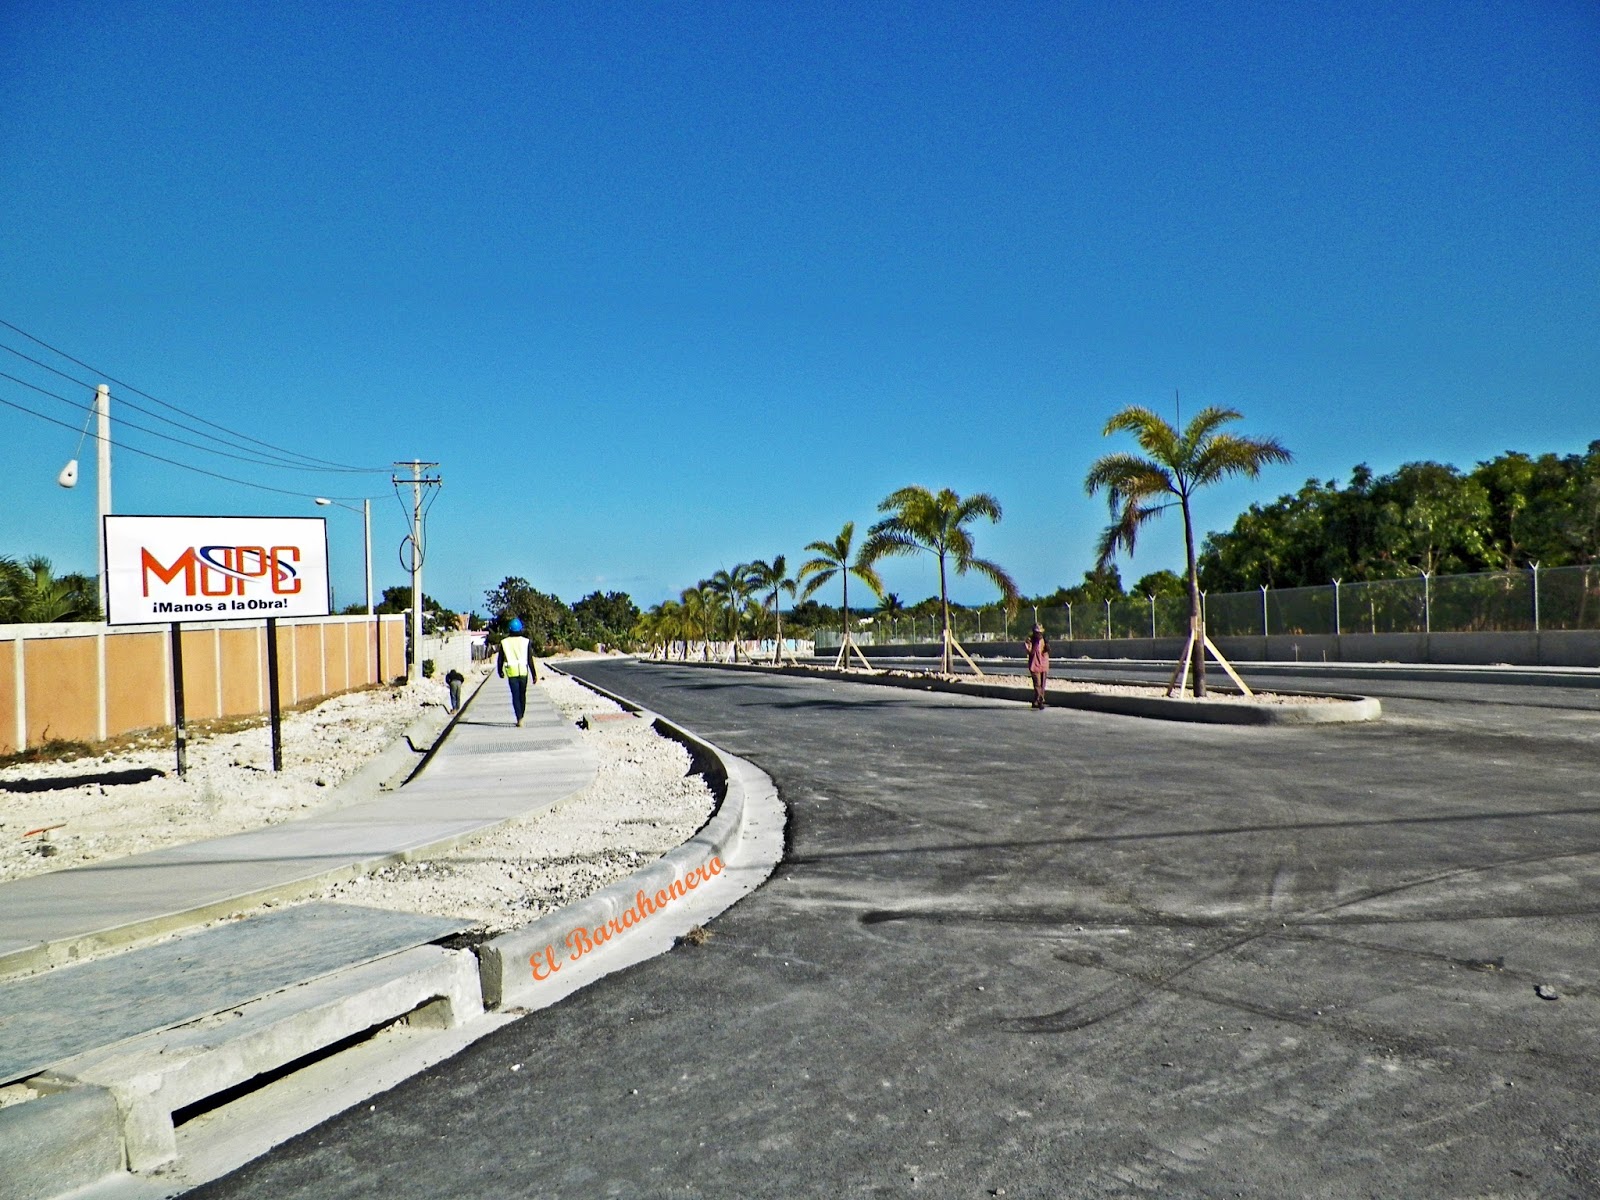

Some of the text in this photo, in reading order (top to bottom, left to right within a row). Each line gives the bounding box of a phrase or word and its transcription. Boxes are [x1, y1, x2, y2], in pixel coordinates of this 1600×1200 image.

[141, 545, 302, 598] MOPC
[152, 598, 288, 613] ¡Manos a la Obra!
